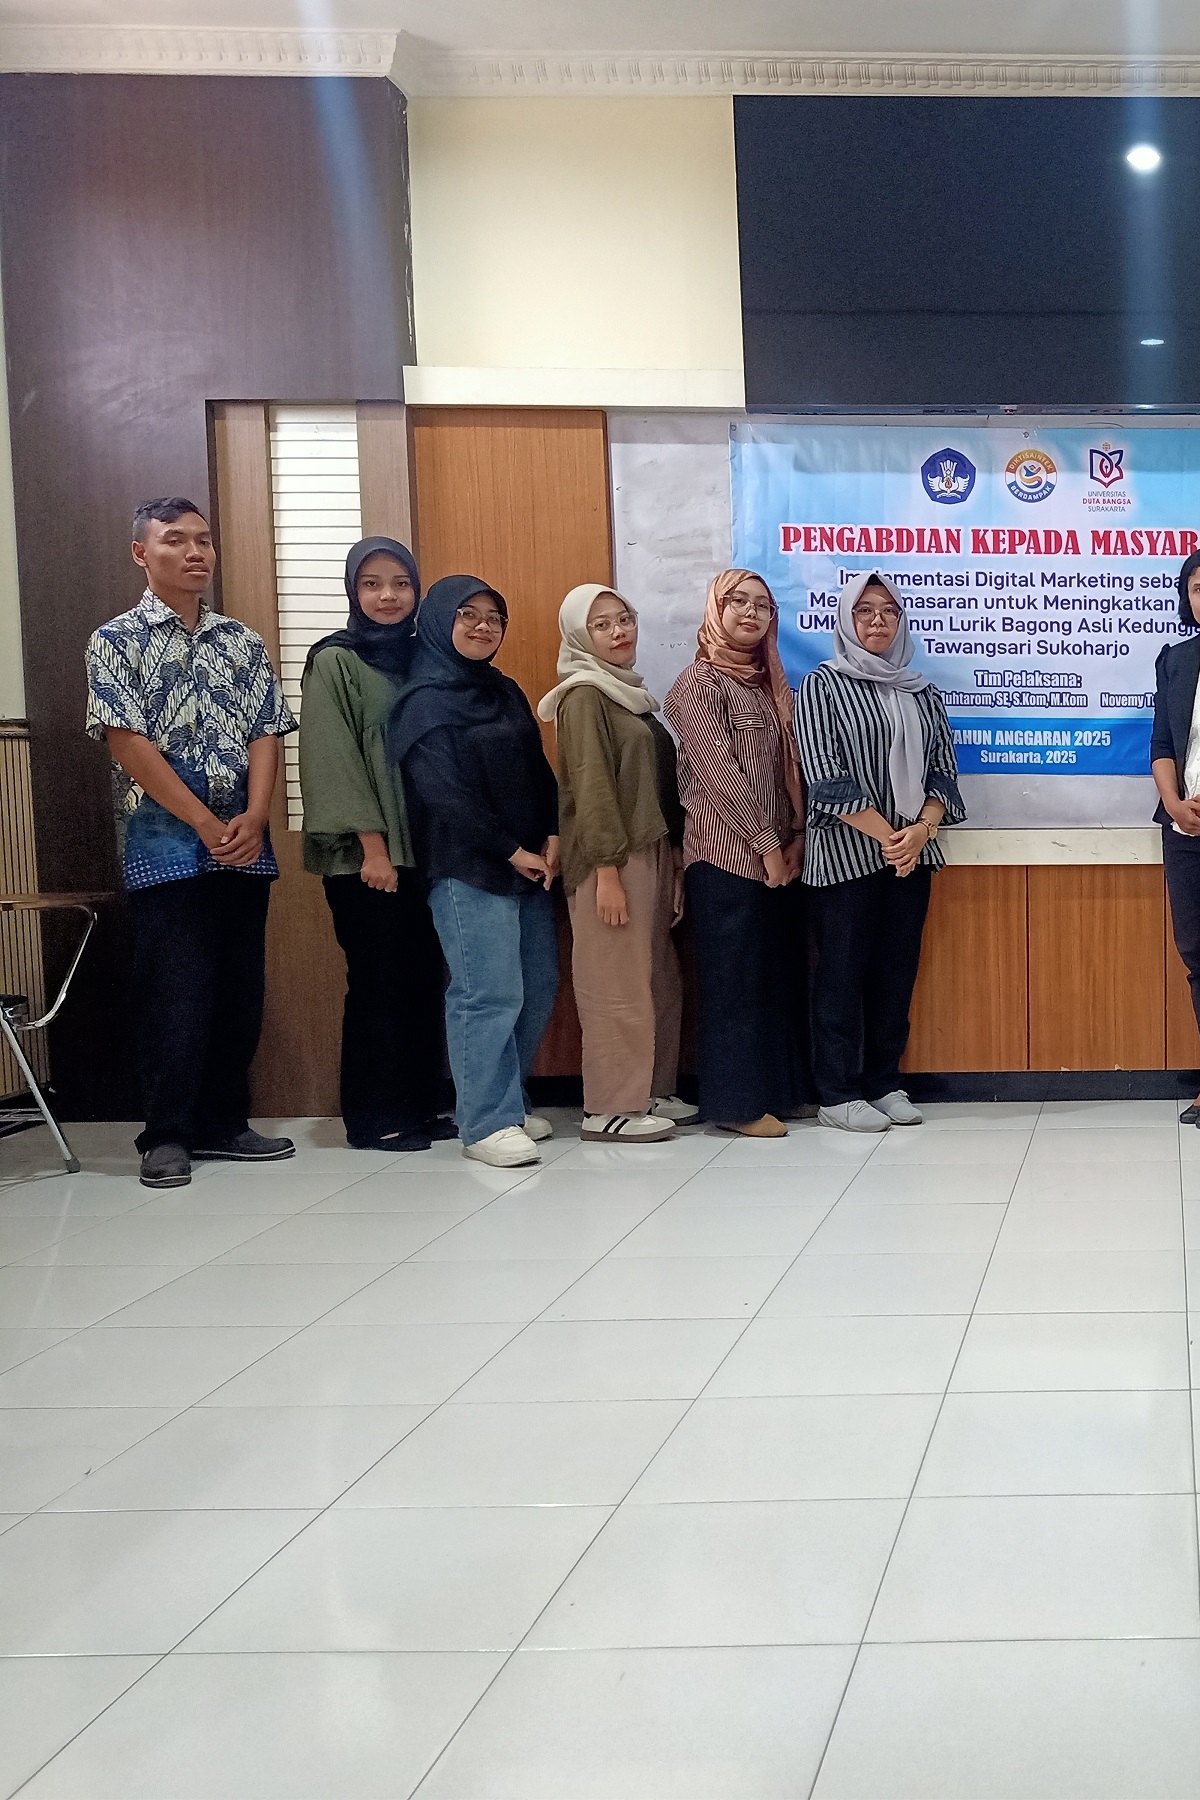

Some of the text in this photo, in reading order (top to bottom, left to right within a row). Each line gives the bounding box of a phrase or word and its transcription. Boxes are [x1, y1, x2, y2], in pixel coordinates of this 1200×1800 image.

[1009, 452, 1054, 471] DIKTISAINTEK
[1010, 485, 1052, 500] BERDAMPAK
[782, 526, 961, 554] PENGABDIAN
[971, 529, 1081, 555] KEPADA
[975, 572, 1035, 591] Digital
[1041, 573, 1134, 592] Marketing
[984, 595, 1037, 609] untuk
[1043, 595, 1175, 613] Meningkatkan
[949, 617, 996, 632] Lurik
[1002, 617, 1072, 636] Bagong
[1078, 618, 1113, 633] Asli
[924, 638, 1130, 658] Tawangsari Sukoharjo
[975, 671, 1082, 687] Tim Pelaksana:
[995, 692, 1012, 707] SE,
[1013, 692, 1048, 708] S.Kom,
[1050, 693, 1087, 707] M.Kom
[1101, 693, 1144, 708] Novemy
[952, 730, 1111, 746] AHUN ANGGARAN 2025
[980, 751, 1076, 764] Surakarta, 2025
